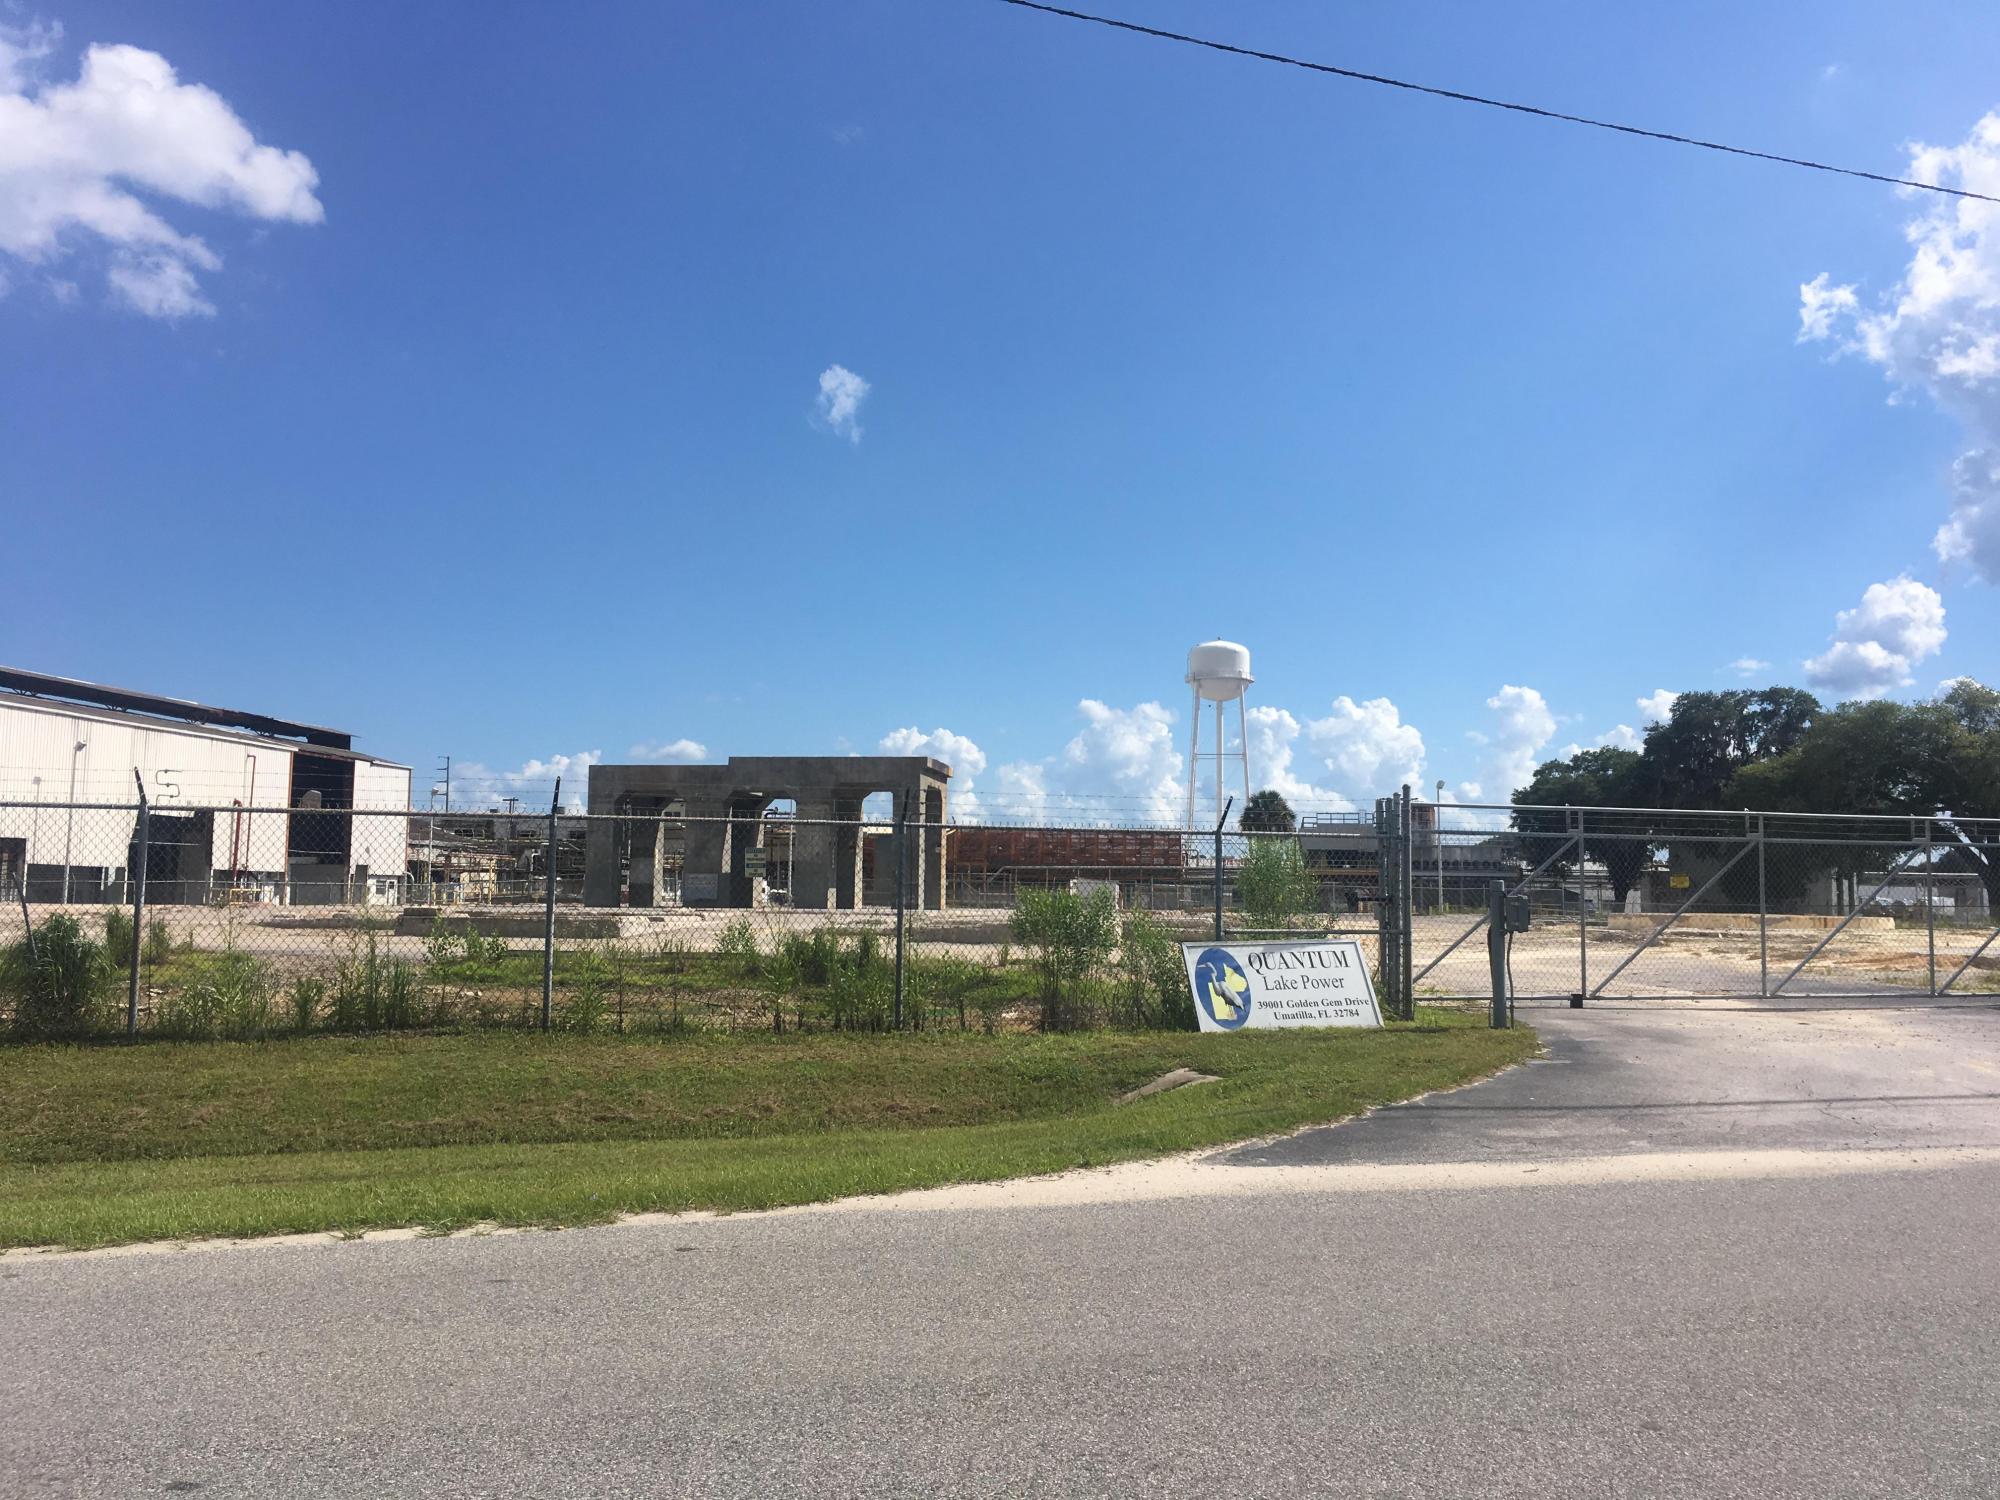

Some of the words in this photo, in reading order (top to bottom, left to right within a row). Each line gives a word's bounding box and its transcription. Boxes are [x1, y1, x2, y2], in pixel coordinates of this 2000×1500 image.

[1247, 950, 1351, 975] QUANTUM
[1263, 975, 1298, 991] Lake
[1300, 974, 1345, 990] Power
[1257, 1000, 1284, 1010] 39001
[1286, 999, 1320, 1009] Golden
[1321, 998, 1343, 1007] Gem
[1344, 997, 1370, 1006] Drive
[1273, 1010, 1317, 1020] Umatilla,
[1318, 1009, 1332, 1019] FL
[1334, 1008, 1360, 1018] 32784
